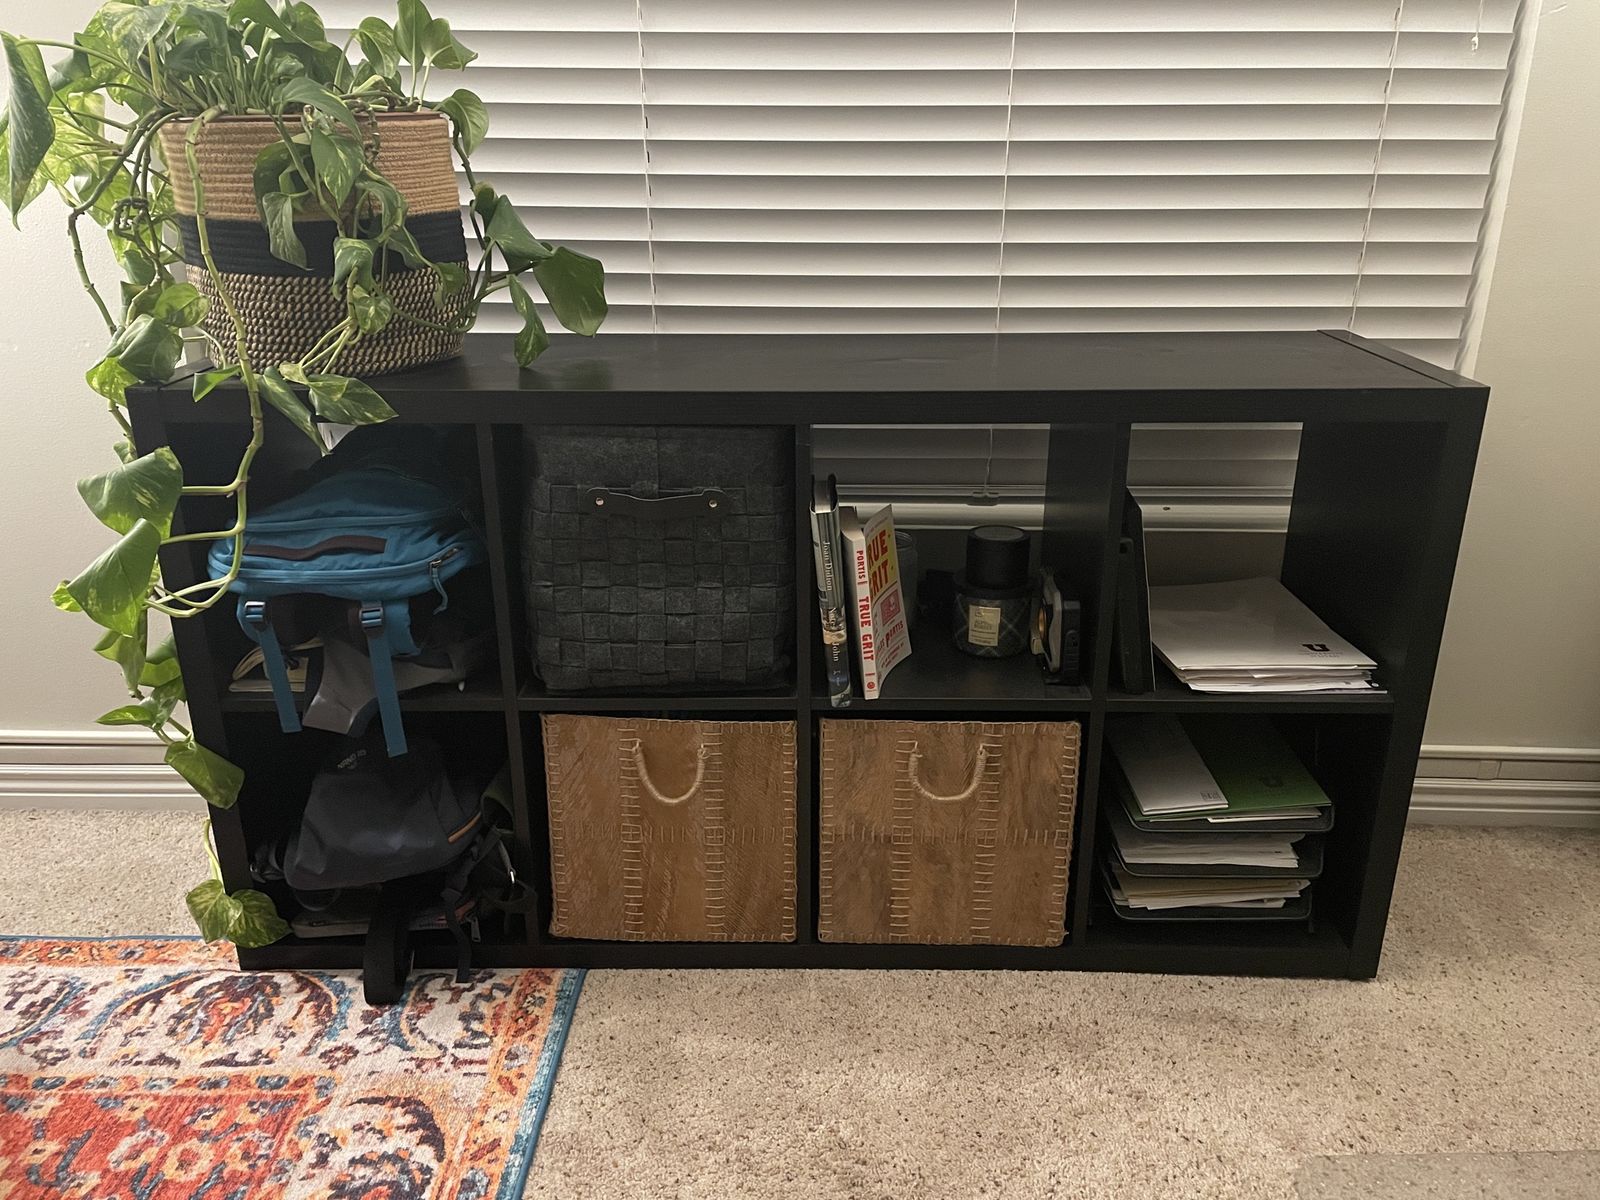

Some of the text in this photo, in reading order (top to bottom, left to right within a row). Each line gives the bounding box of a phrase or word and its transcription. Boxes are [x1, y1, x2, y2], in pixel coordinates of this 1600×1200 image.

[822, 540, 834, 591] Joan Didion
[856, 550, 866, 579] PORTIS
[867, 529, 888, 568] RUE
[870, 559, 890, 602] RIT
[828, 607, 838, 629] Notes
[858, 596, 874, 661] TRUE GRIT
[831, 641, 840, 662] John
